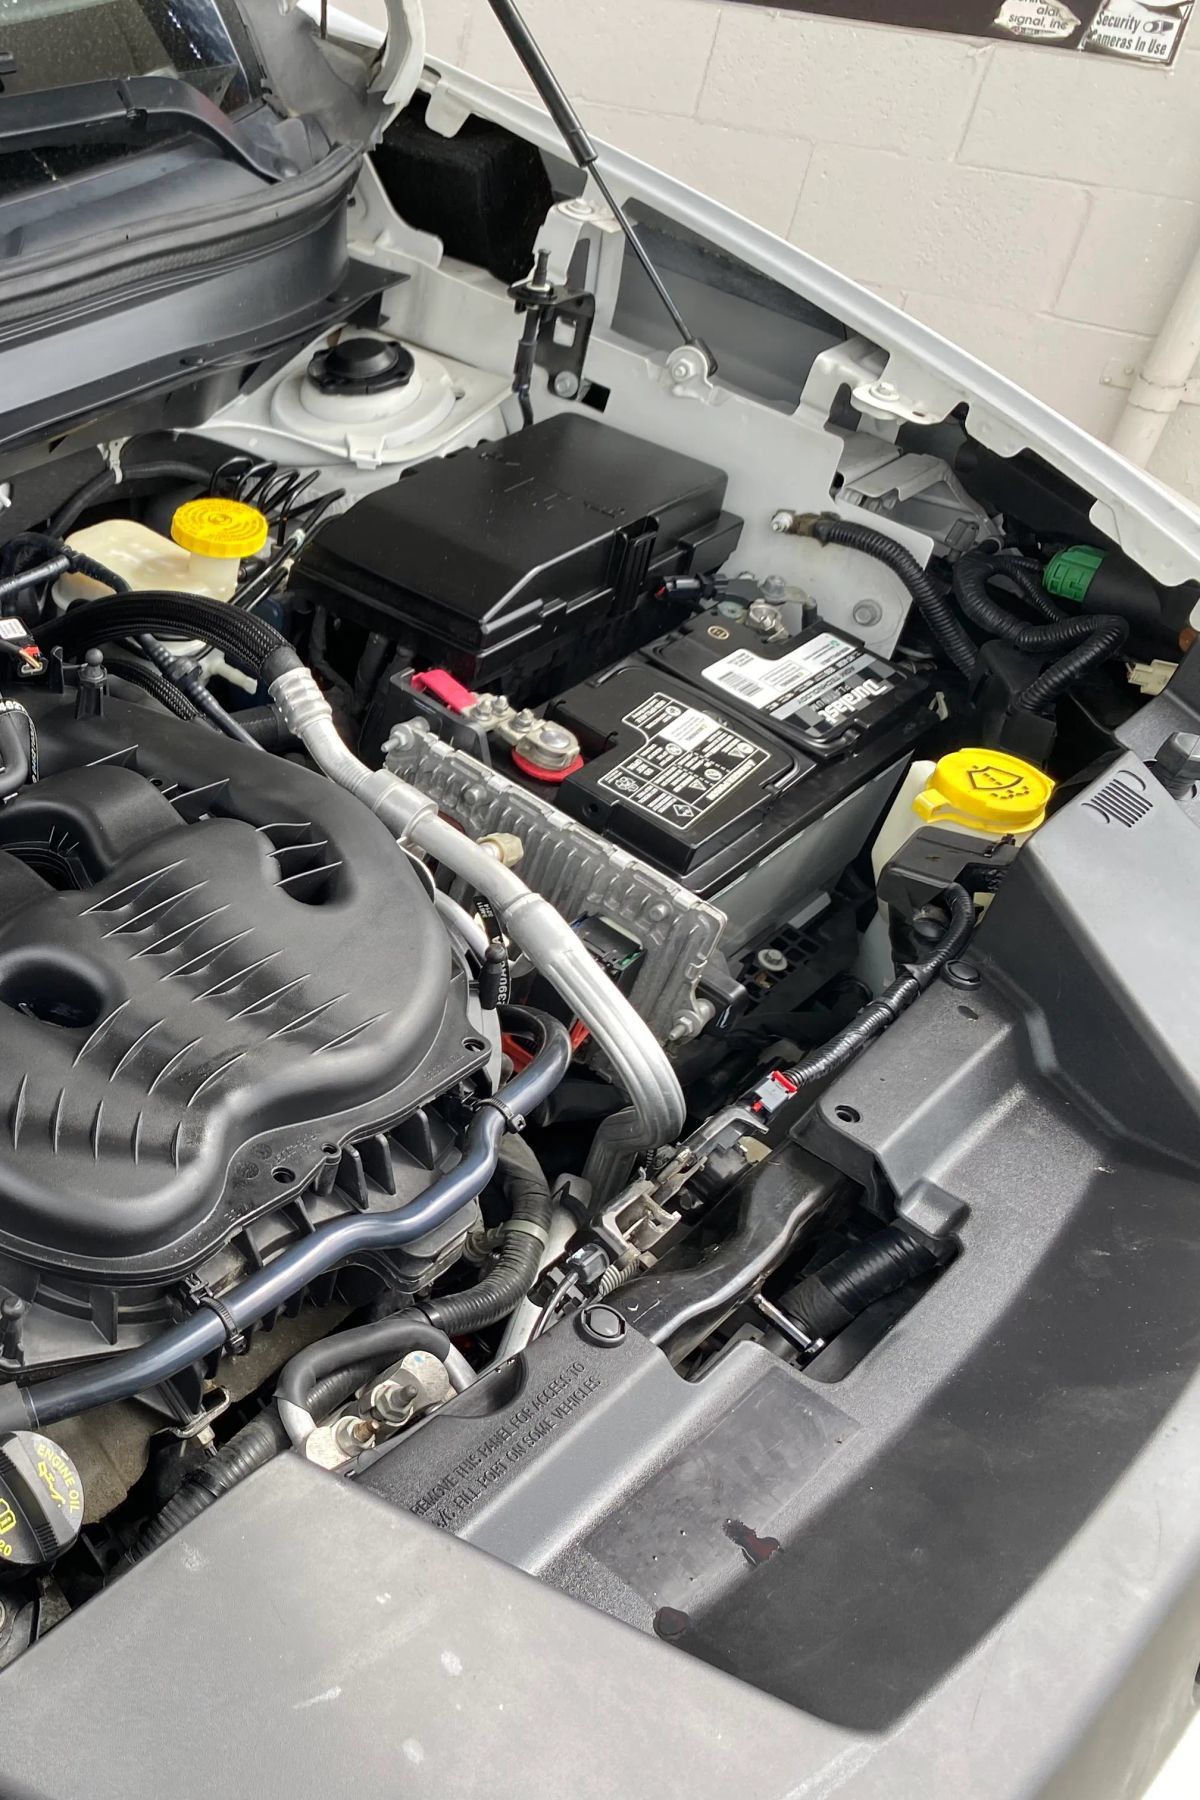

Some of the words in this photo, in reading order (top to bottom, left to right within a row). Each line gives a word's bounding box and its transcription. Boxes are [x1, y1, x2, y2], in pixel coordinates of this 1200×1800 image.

[1096, 11, 1141, 34] Security
[1135, 37, 1146, 51] In
[1149, 40, 1167, 55] Use
[817, 678, 887, 725] Duralast
[453, 1453, 483, 1480] THIS
[478, 1425, 517, 1460] PANEL
[510, 1407, 535, 1431] FOR
[532, 1373, 572, 1412] ACCESS
[567, 1361, 585, 1380] TO
[477, 1459, 508, 1490] PORT
[505, 1444, 525, 1465] ON
[522, 1417, 557, 1448] SOME
[551, 1374, 601, 1420] VEHICLES
[36, 1443, 76, 1487] ENGINE
[68, 1489, 81, 1514] OIL
